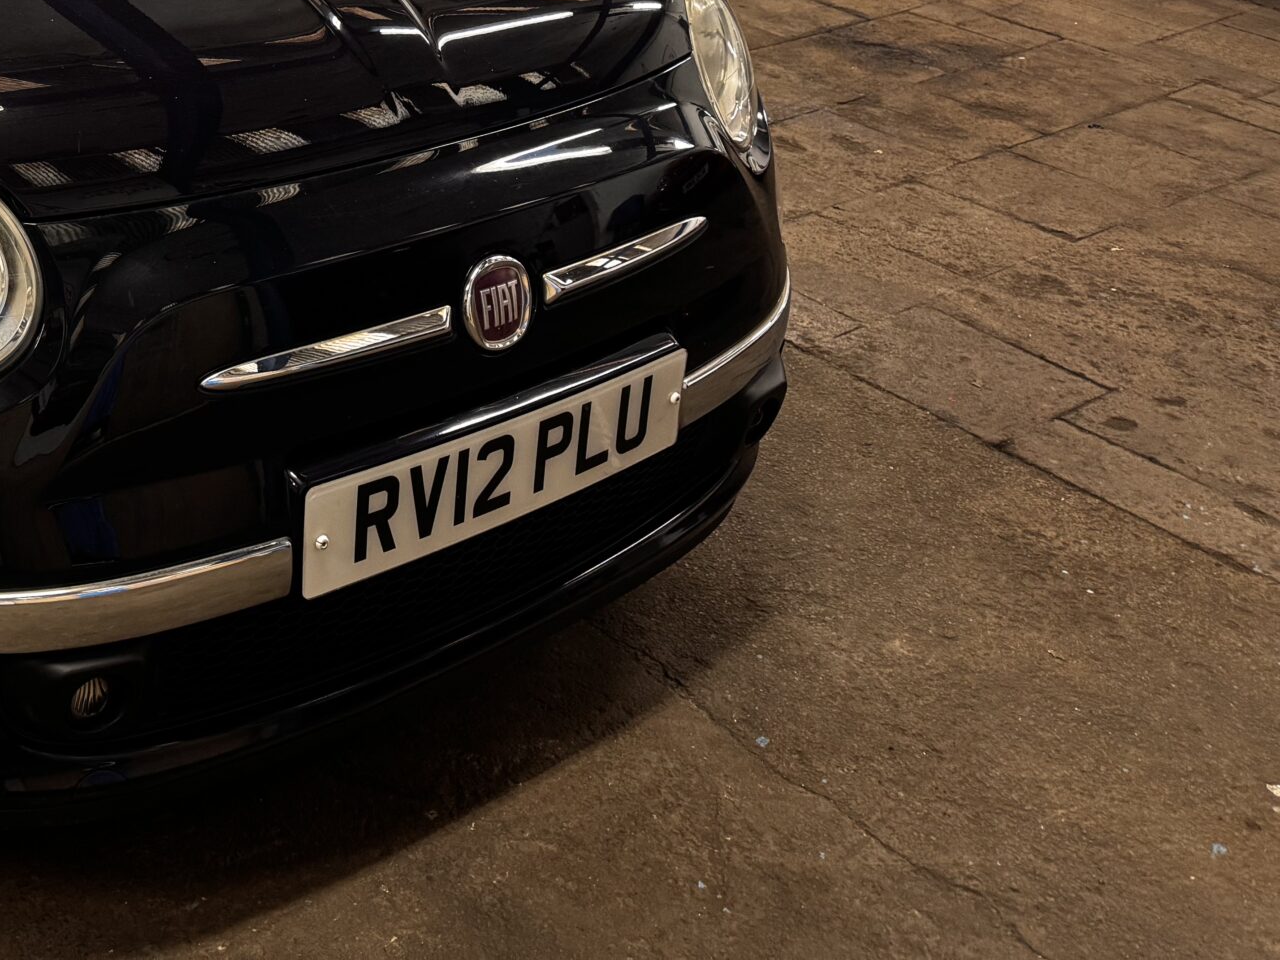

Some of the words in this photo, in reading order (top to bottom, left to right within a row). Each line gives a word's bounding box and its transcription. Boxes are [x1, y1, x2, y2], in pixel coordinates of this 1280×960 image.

[479, 279, 519, 331] FIAT
[353, 434, 517, 564] RV12
[532, 375, 654, 494] PLU
